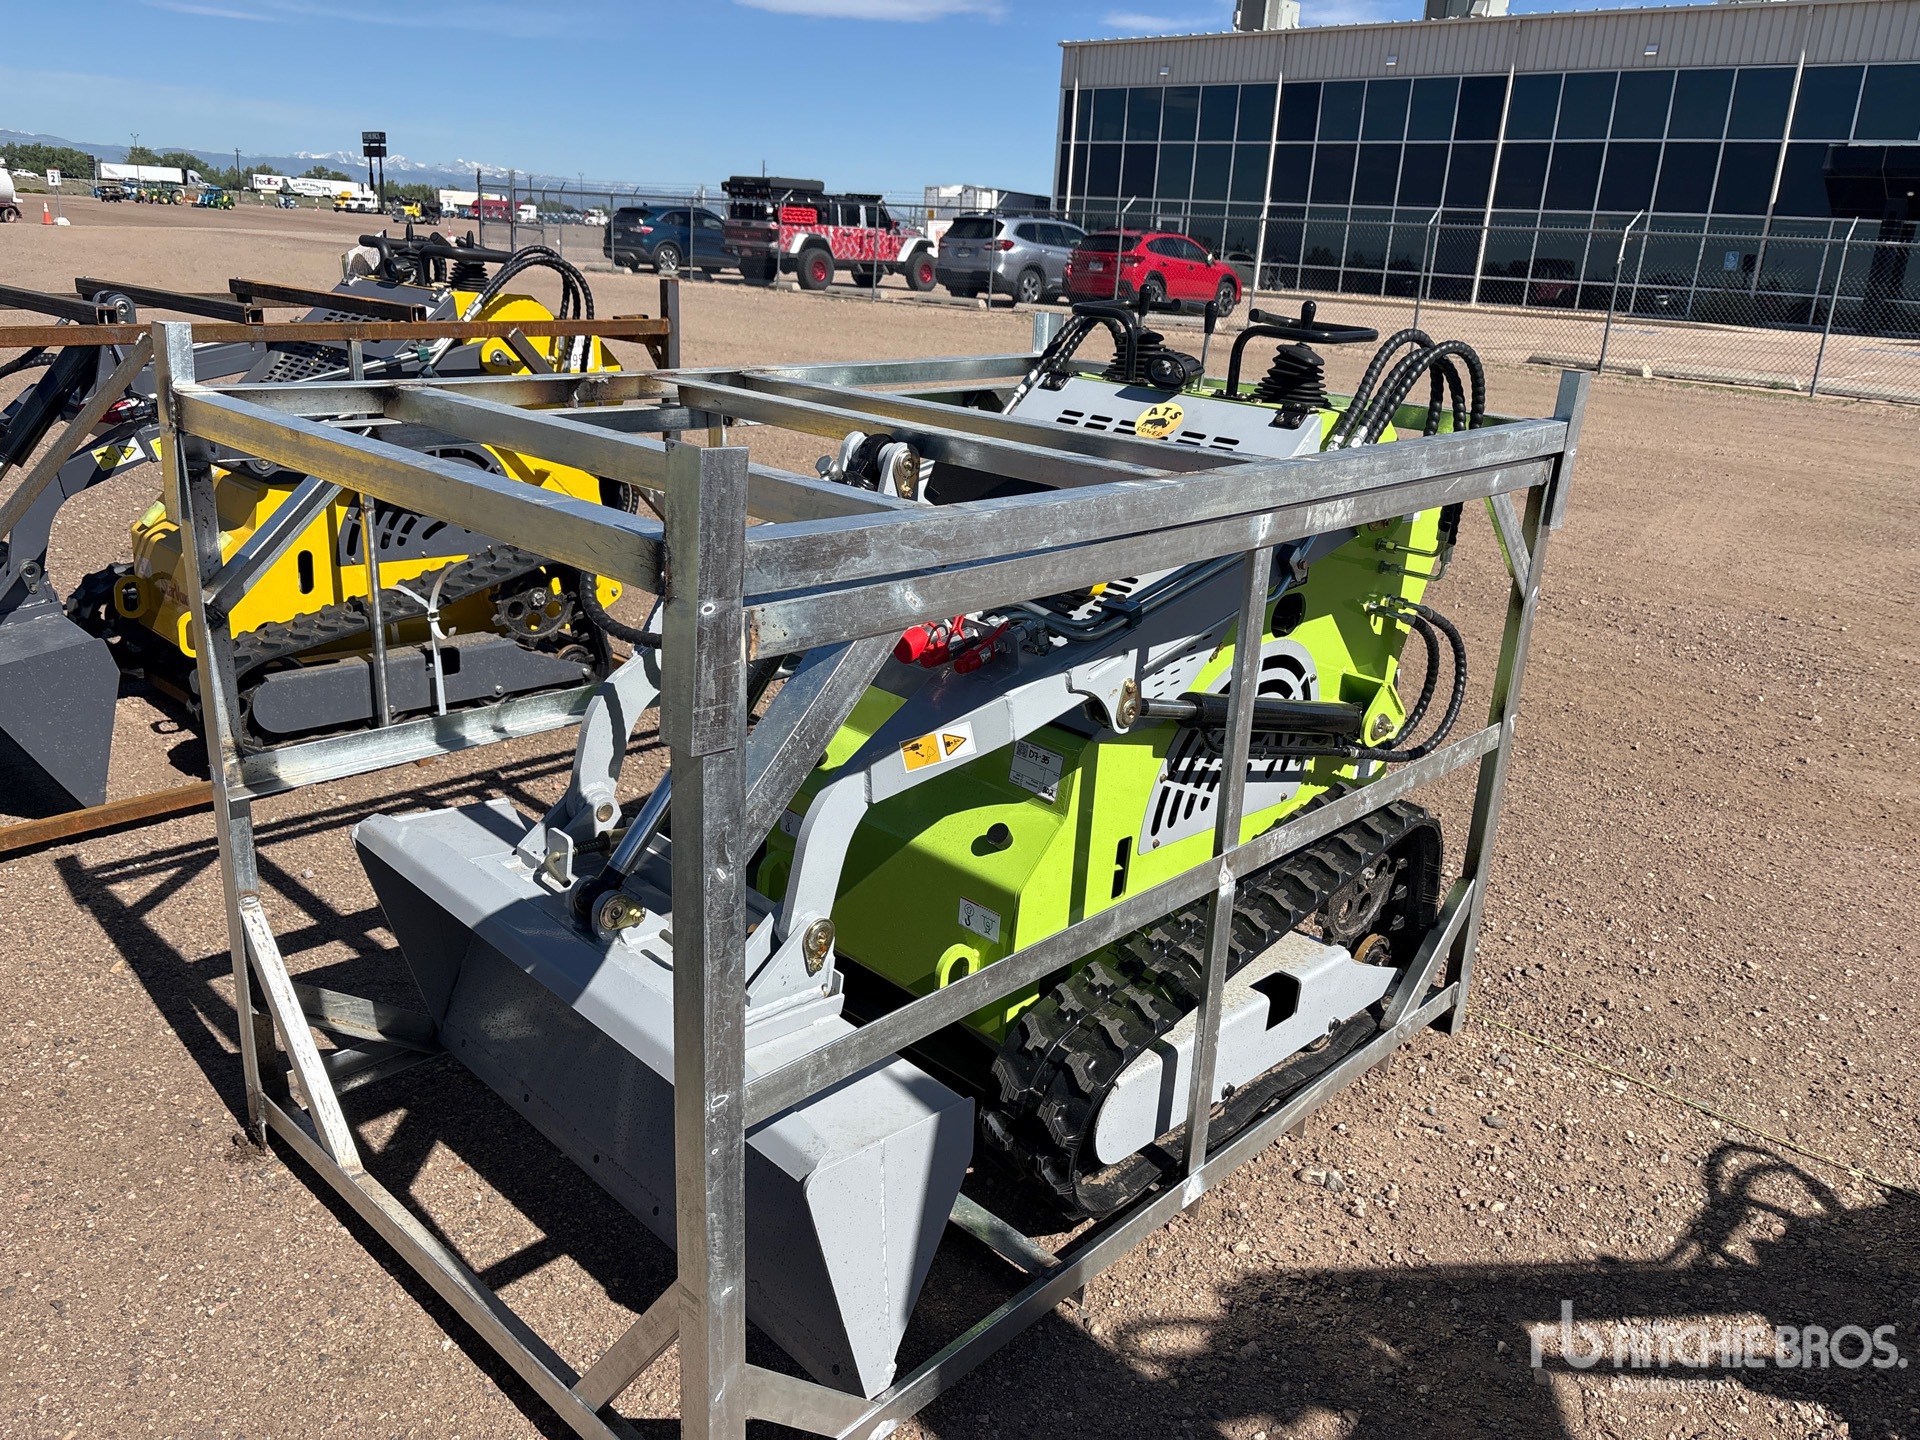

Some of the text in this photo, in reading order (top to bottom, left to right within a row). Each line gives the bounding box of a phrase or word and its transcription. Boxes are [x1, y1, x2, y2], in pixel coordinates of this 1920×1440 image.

[50, 174, 56, 182] 2
[255, 177, 278, 186] FedEx
[1148, 407, 1182, 420] ATS
[1137, 426, 1162, 436] POWER
